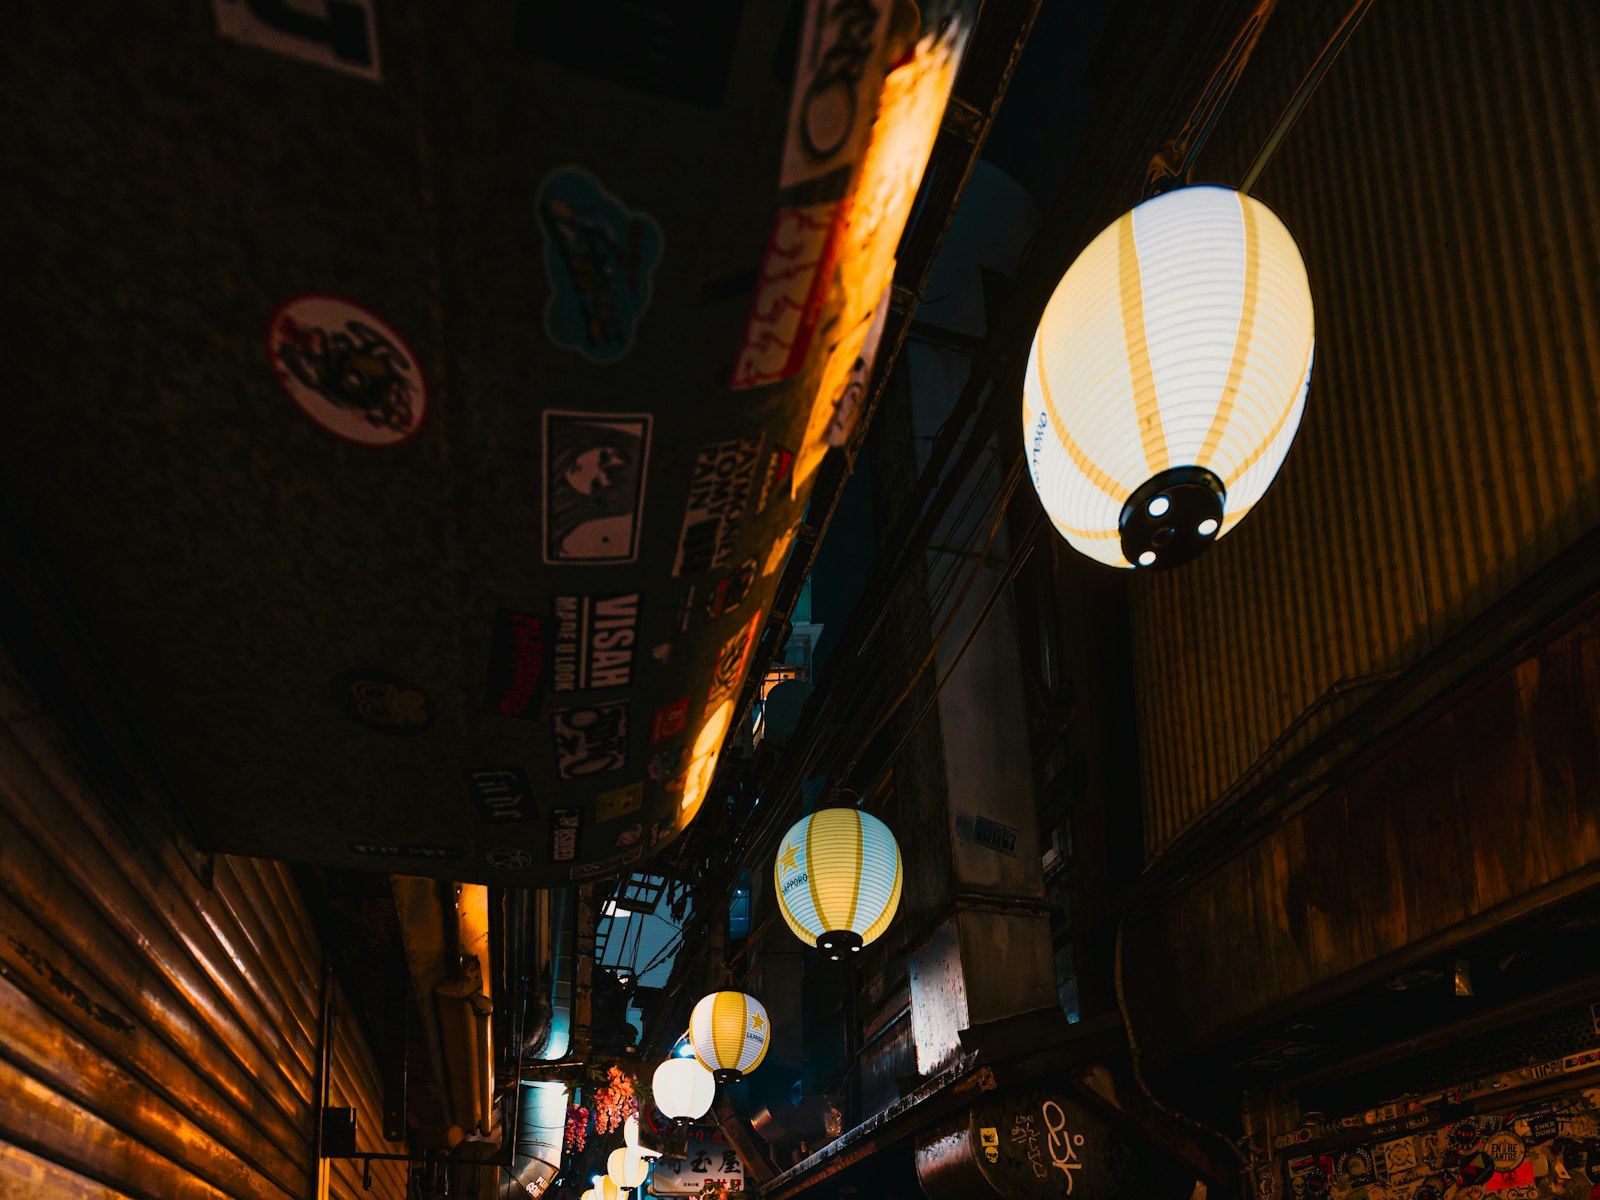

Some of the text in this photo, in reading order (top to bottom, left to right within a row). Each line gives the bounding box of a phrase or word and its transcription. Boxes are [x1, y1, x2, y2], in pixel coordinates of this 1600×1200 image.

[690, 444, 718, 511] PAIN
[554, 643, 577, 653] U
[590, 592, 639, 689] VISAH
[554, 656, 577, 691] LOOK
[781, 874, 808, 895] SAPPORO
[1535, 1127, 1557, 1138] DUNK
[1490, 1152, 1517, 1162] SANTOS
